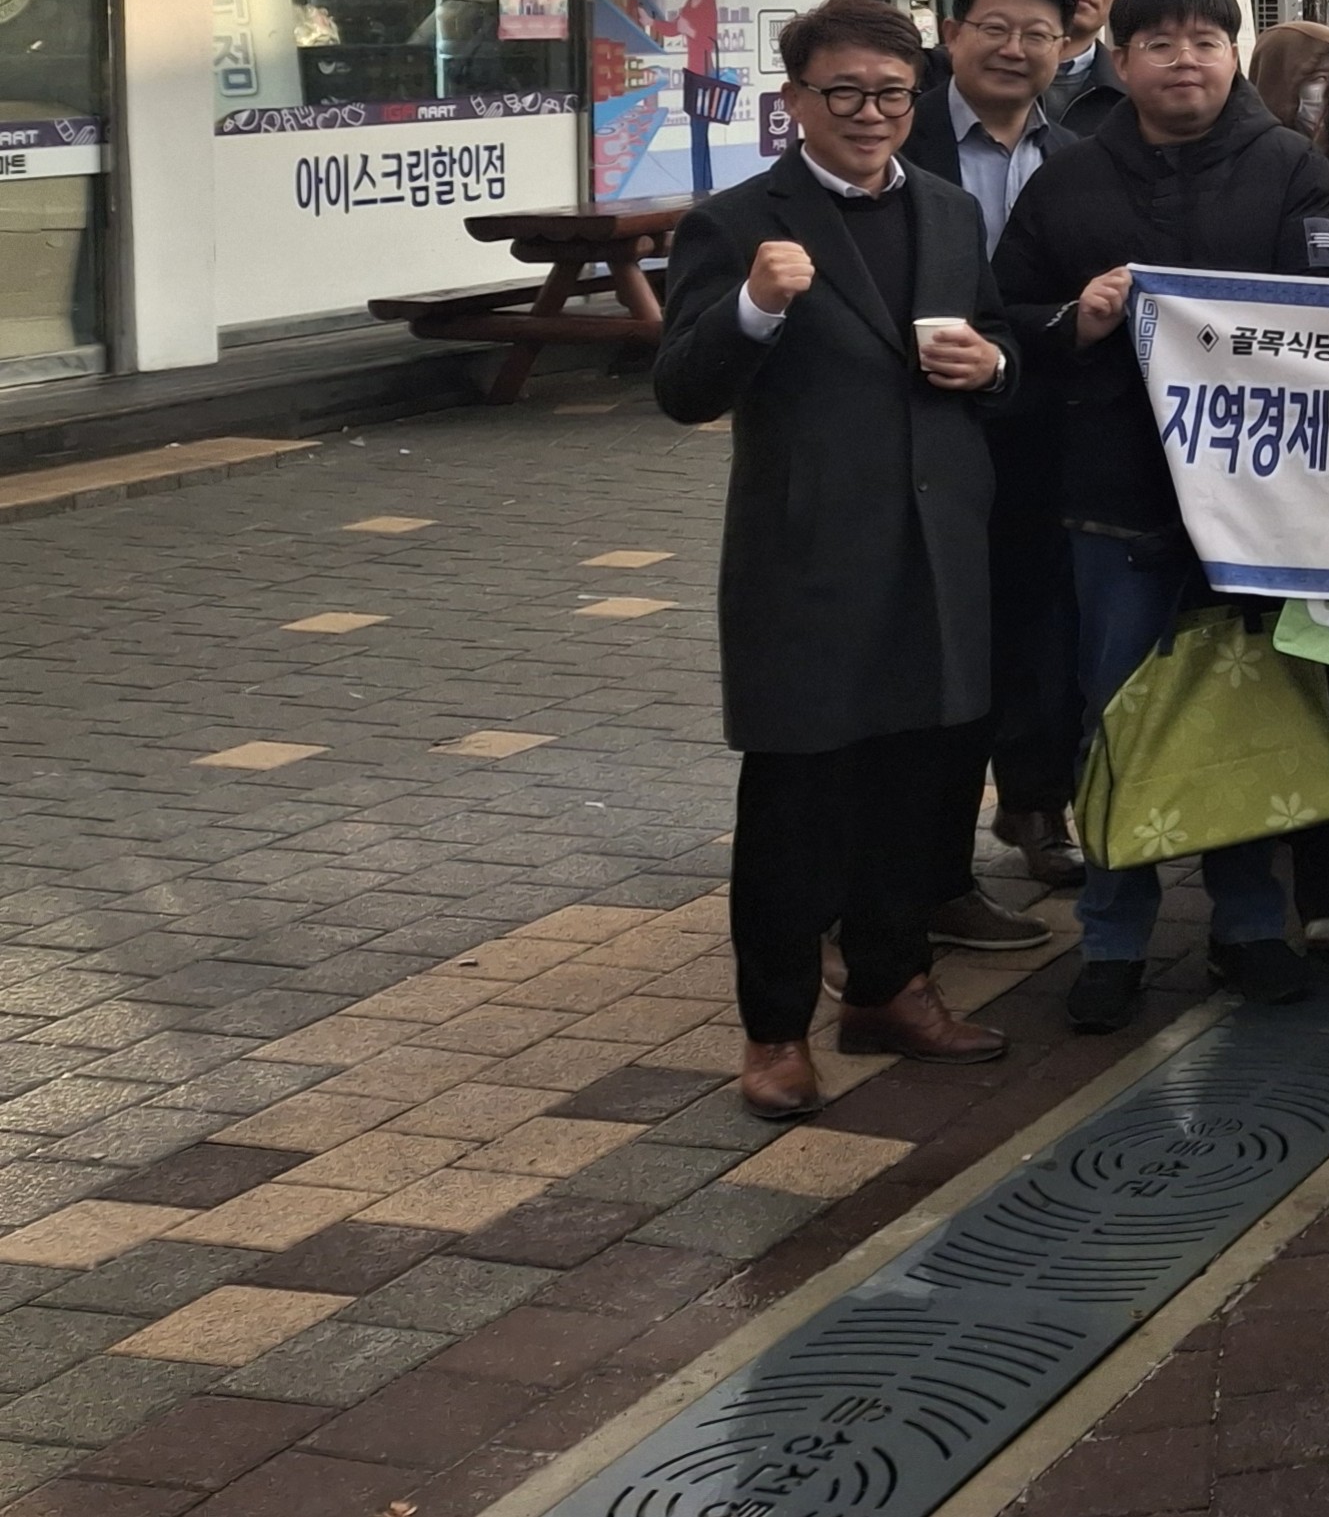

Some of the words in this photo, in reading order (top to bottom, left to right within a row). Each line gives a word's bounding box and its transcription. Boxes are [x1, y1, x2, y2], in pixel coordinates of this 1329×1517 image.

[418, 105, 457, 119] MART
[295, 142, 506, 216] 아이스크림할인점
[1162, 385, 1329, 477] 지역경제
